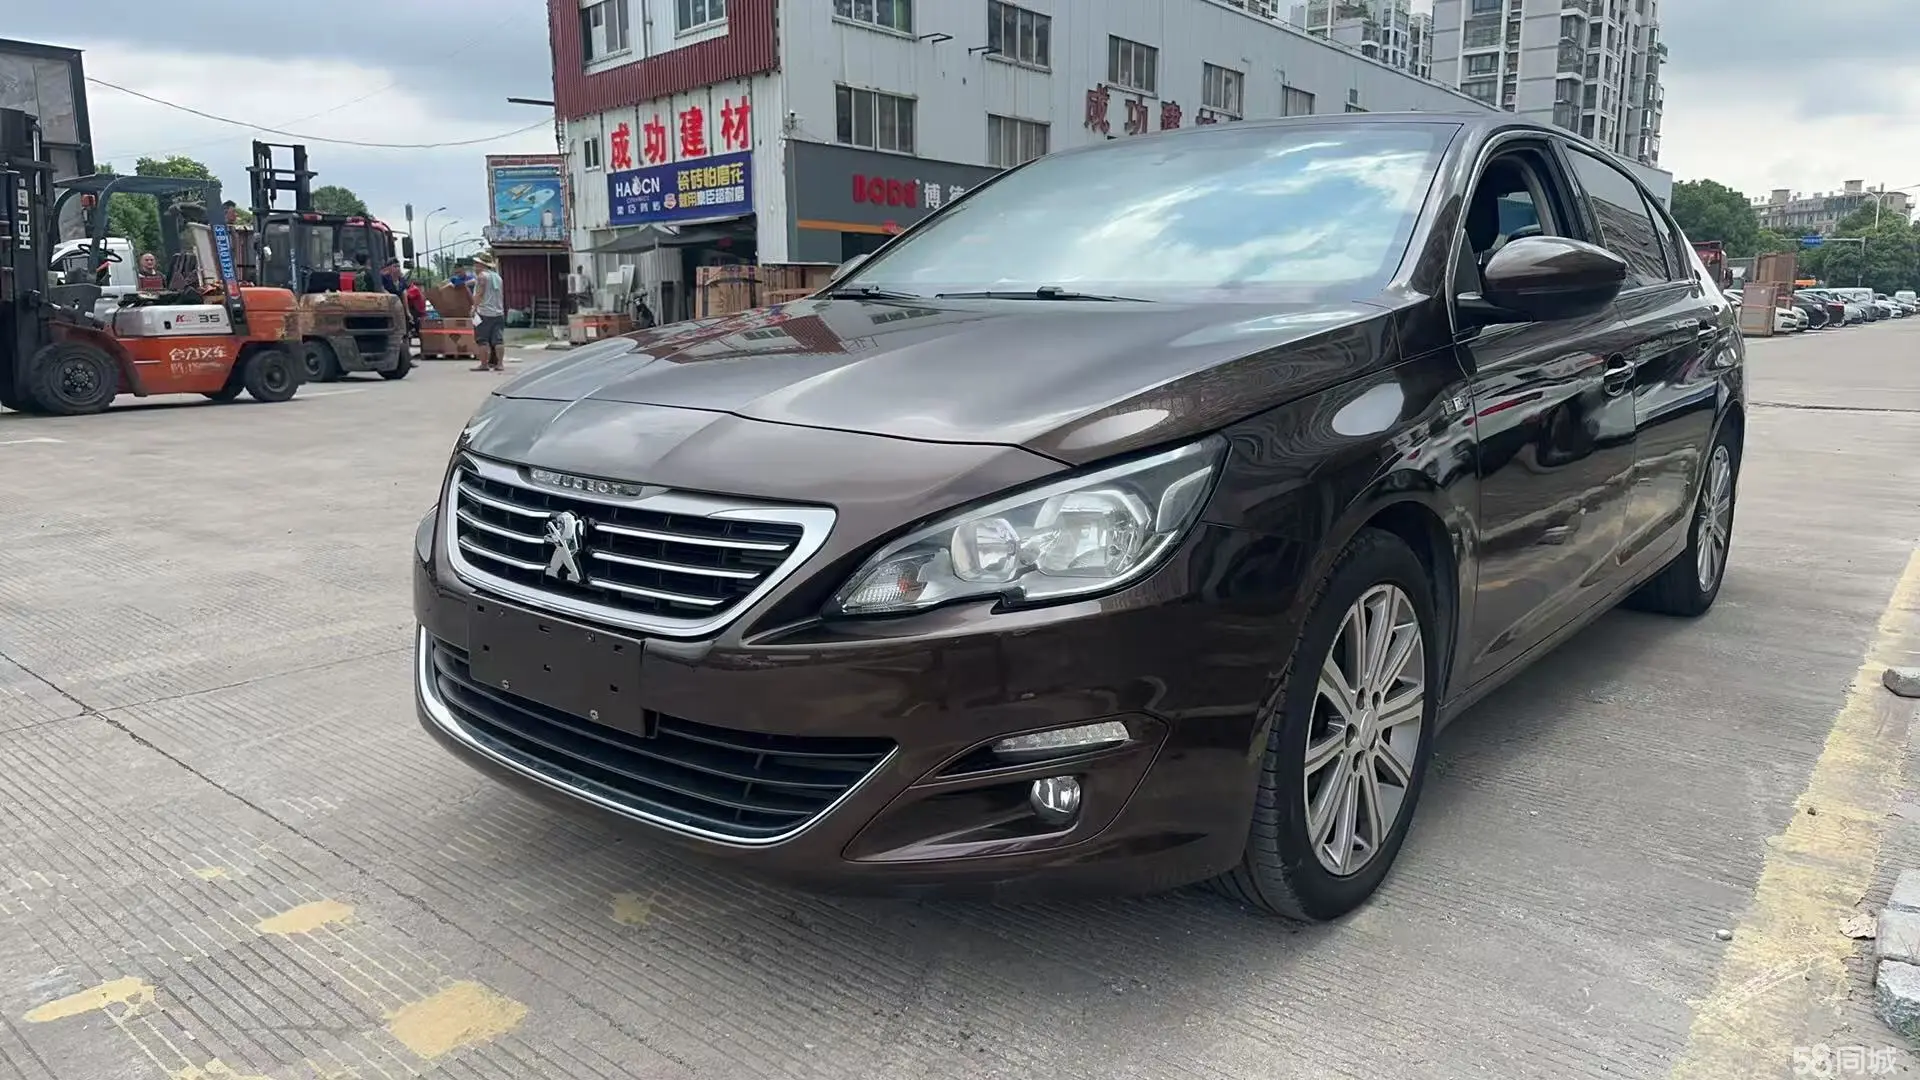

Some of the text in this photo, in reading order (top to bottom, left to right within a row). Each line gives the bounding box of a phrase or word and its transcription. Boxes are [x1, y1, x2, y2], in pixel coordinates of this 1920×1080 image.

[610, 96, 751, 169] 成功建材
[677, 162, 744, 191] 瓷砖怕磨花
[200, 314, 220, 323] 35
